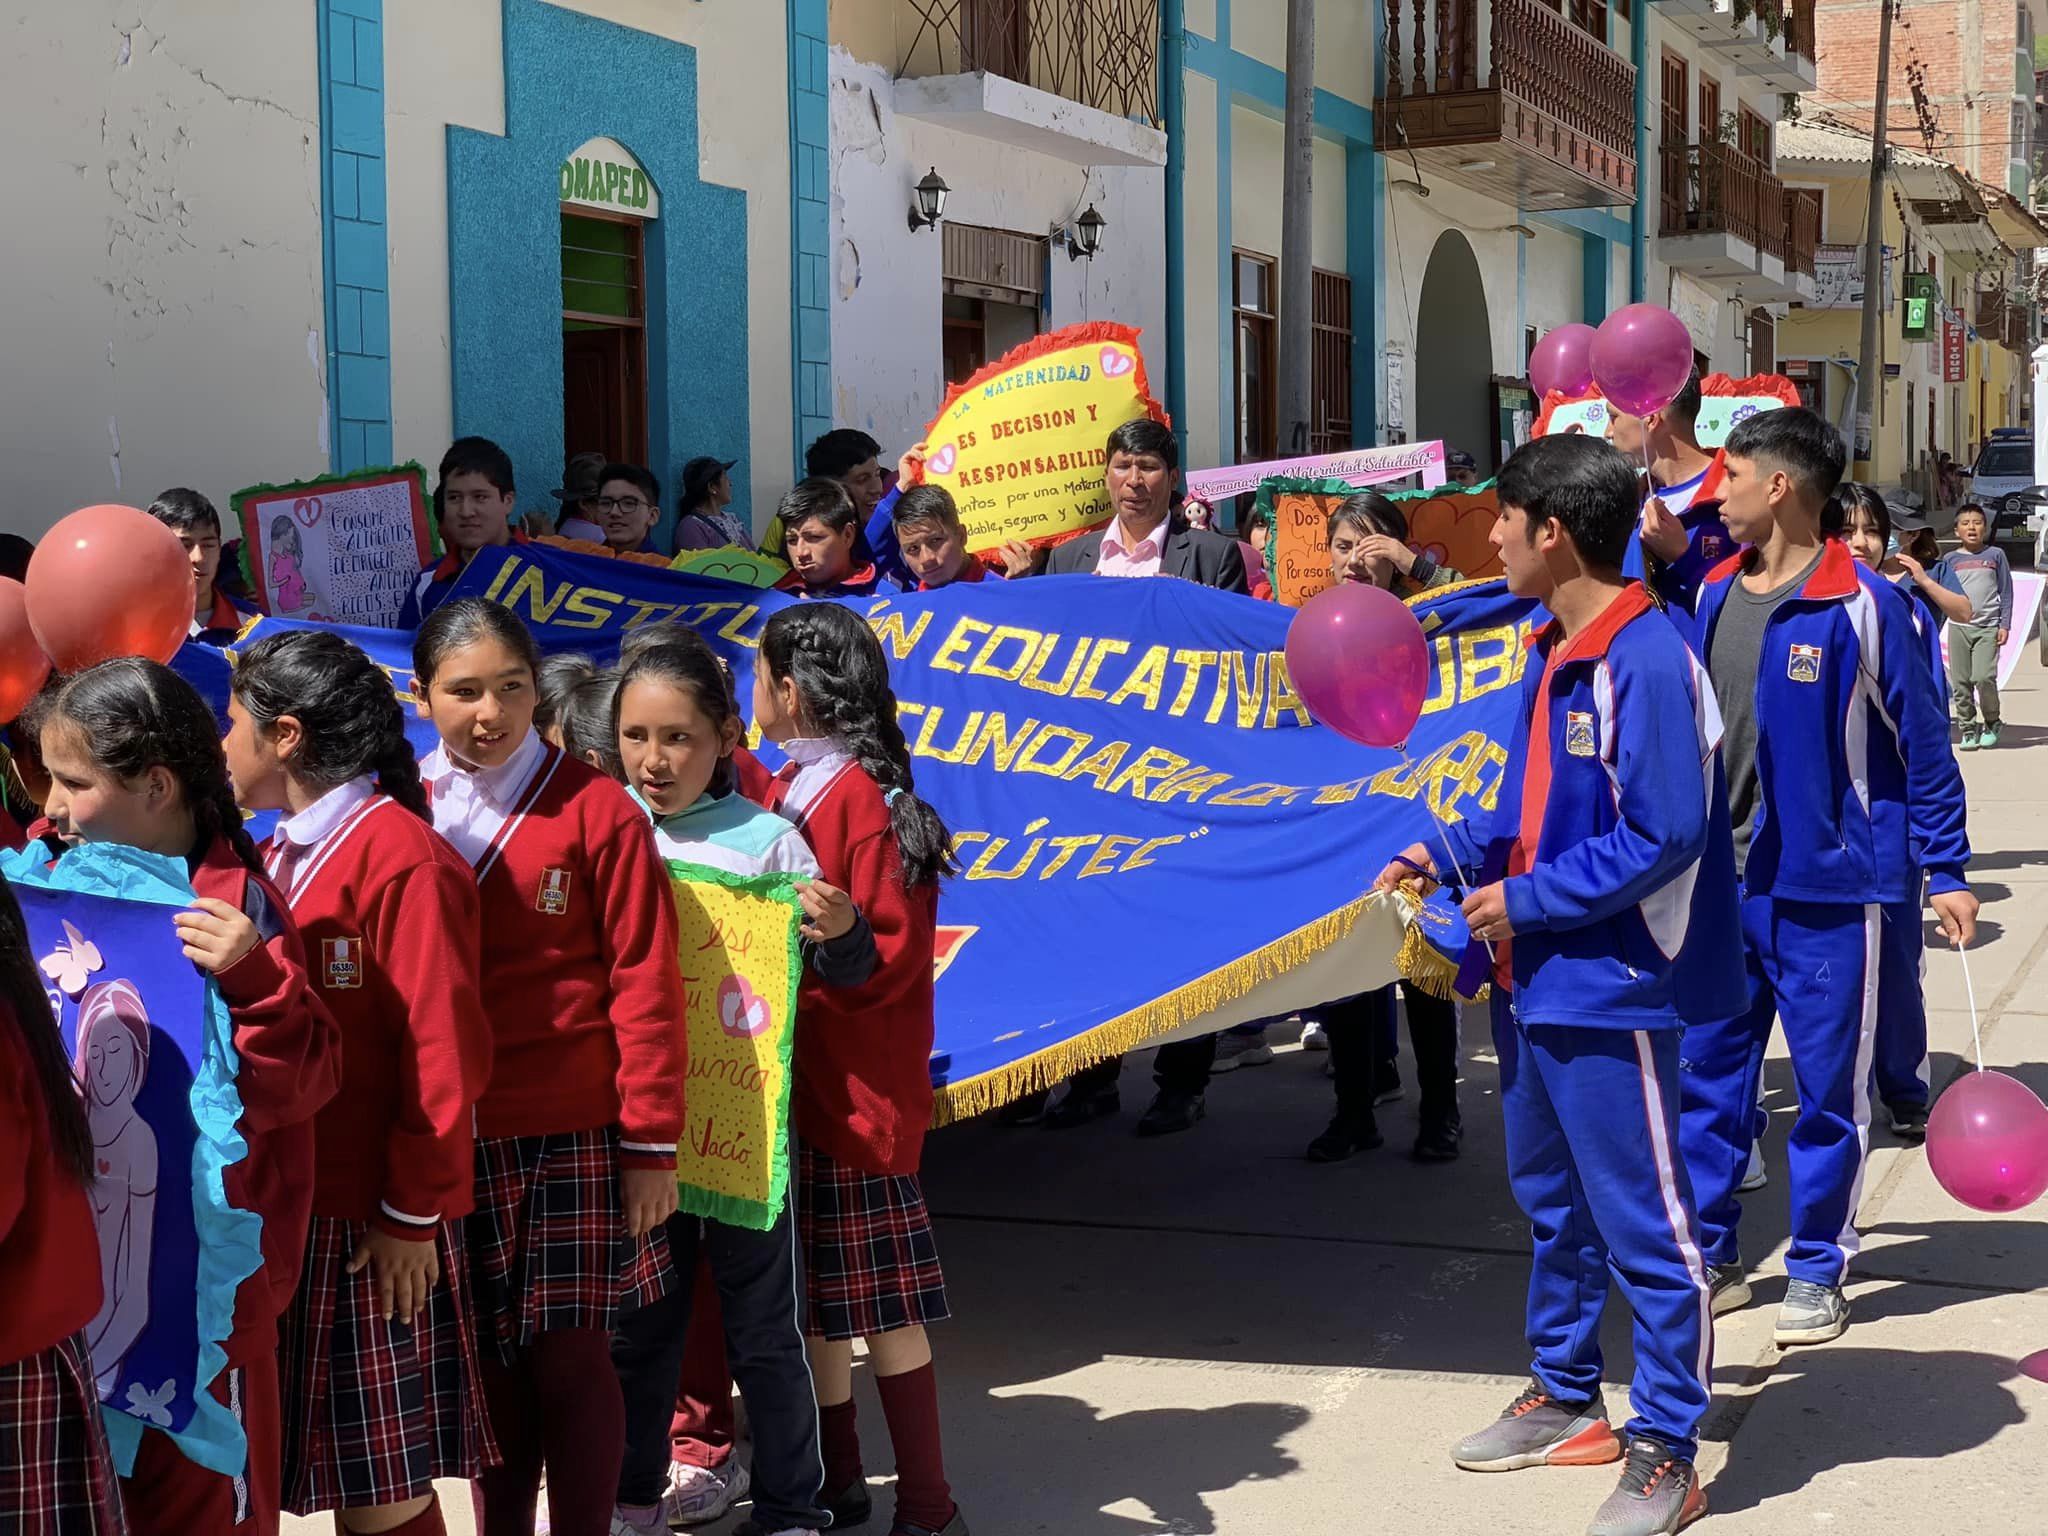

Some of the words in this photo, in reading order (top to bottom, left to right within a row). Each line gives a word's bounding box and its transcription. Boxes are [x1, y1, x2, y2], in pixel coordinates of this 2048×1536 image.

[1949, 346, 1962, 380] TOURS
[952, 402, 971, 420] LA
[983, 365, 1091, 400] MATERNIDAD
[957, 431, 977, 450] ES
[1086, 404, 1098, 421] Y
[958, 448, 1106, 488] RESPONSABILID
[1284, 457, 1364, 479] Maternidad
[957, 496, 997, 515] untos
[1007, 491, 1030, 508] por
[1034, 487, 1059, 498] una
[1064, 474, 1106, 495] Matern
[966, 519, 1003, 537] dable,
[1004, 513, 1049, 532] segura
[1058, 507, 1067, 522] y
[1074, 499, 1112, 517] Volun
[1294, 508, 1320, 527] Dos
[346, 522, 412, 552] ALIMENTOS
[1286, 558, 1301, 579] Por
[1303, 568, 1324, 578] eso
[929, 616, 1313, 729] EDUCATIVA
[686, 1058, 770, 1093] unca
